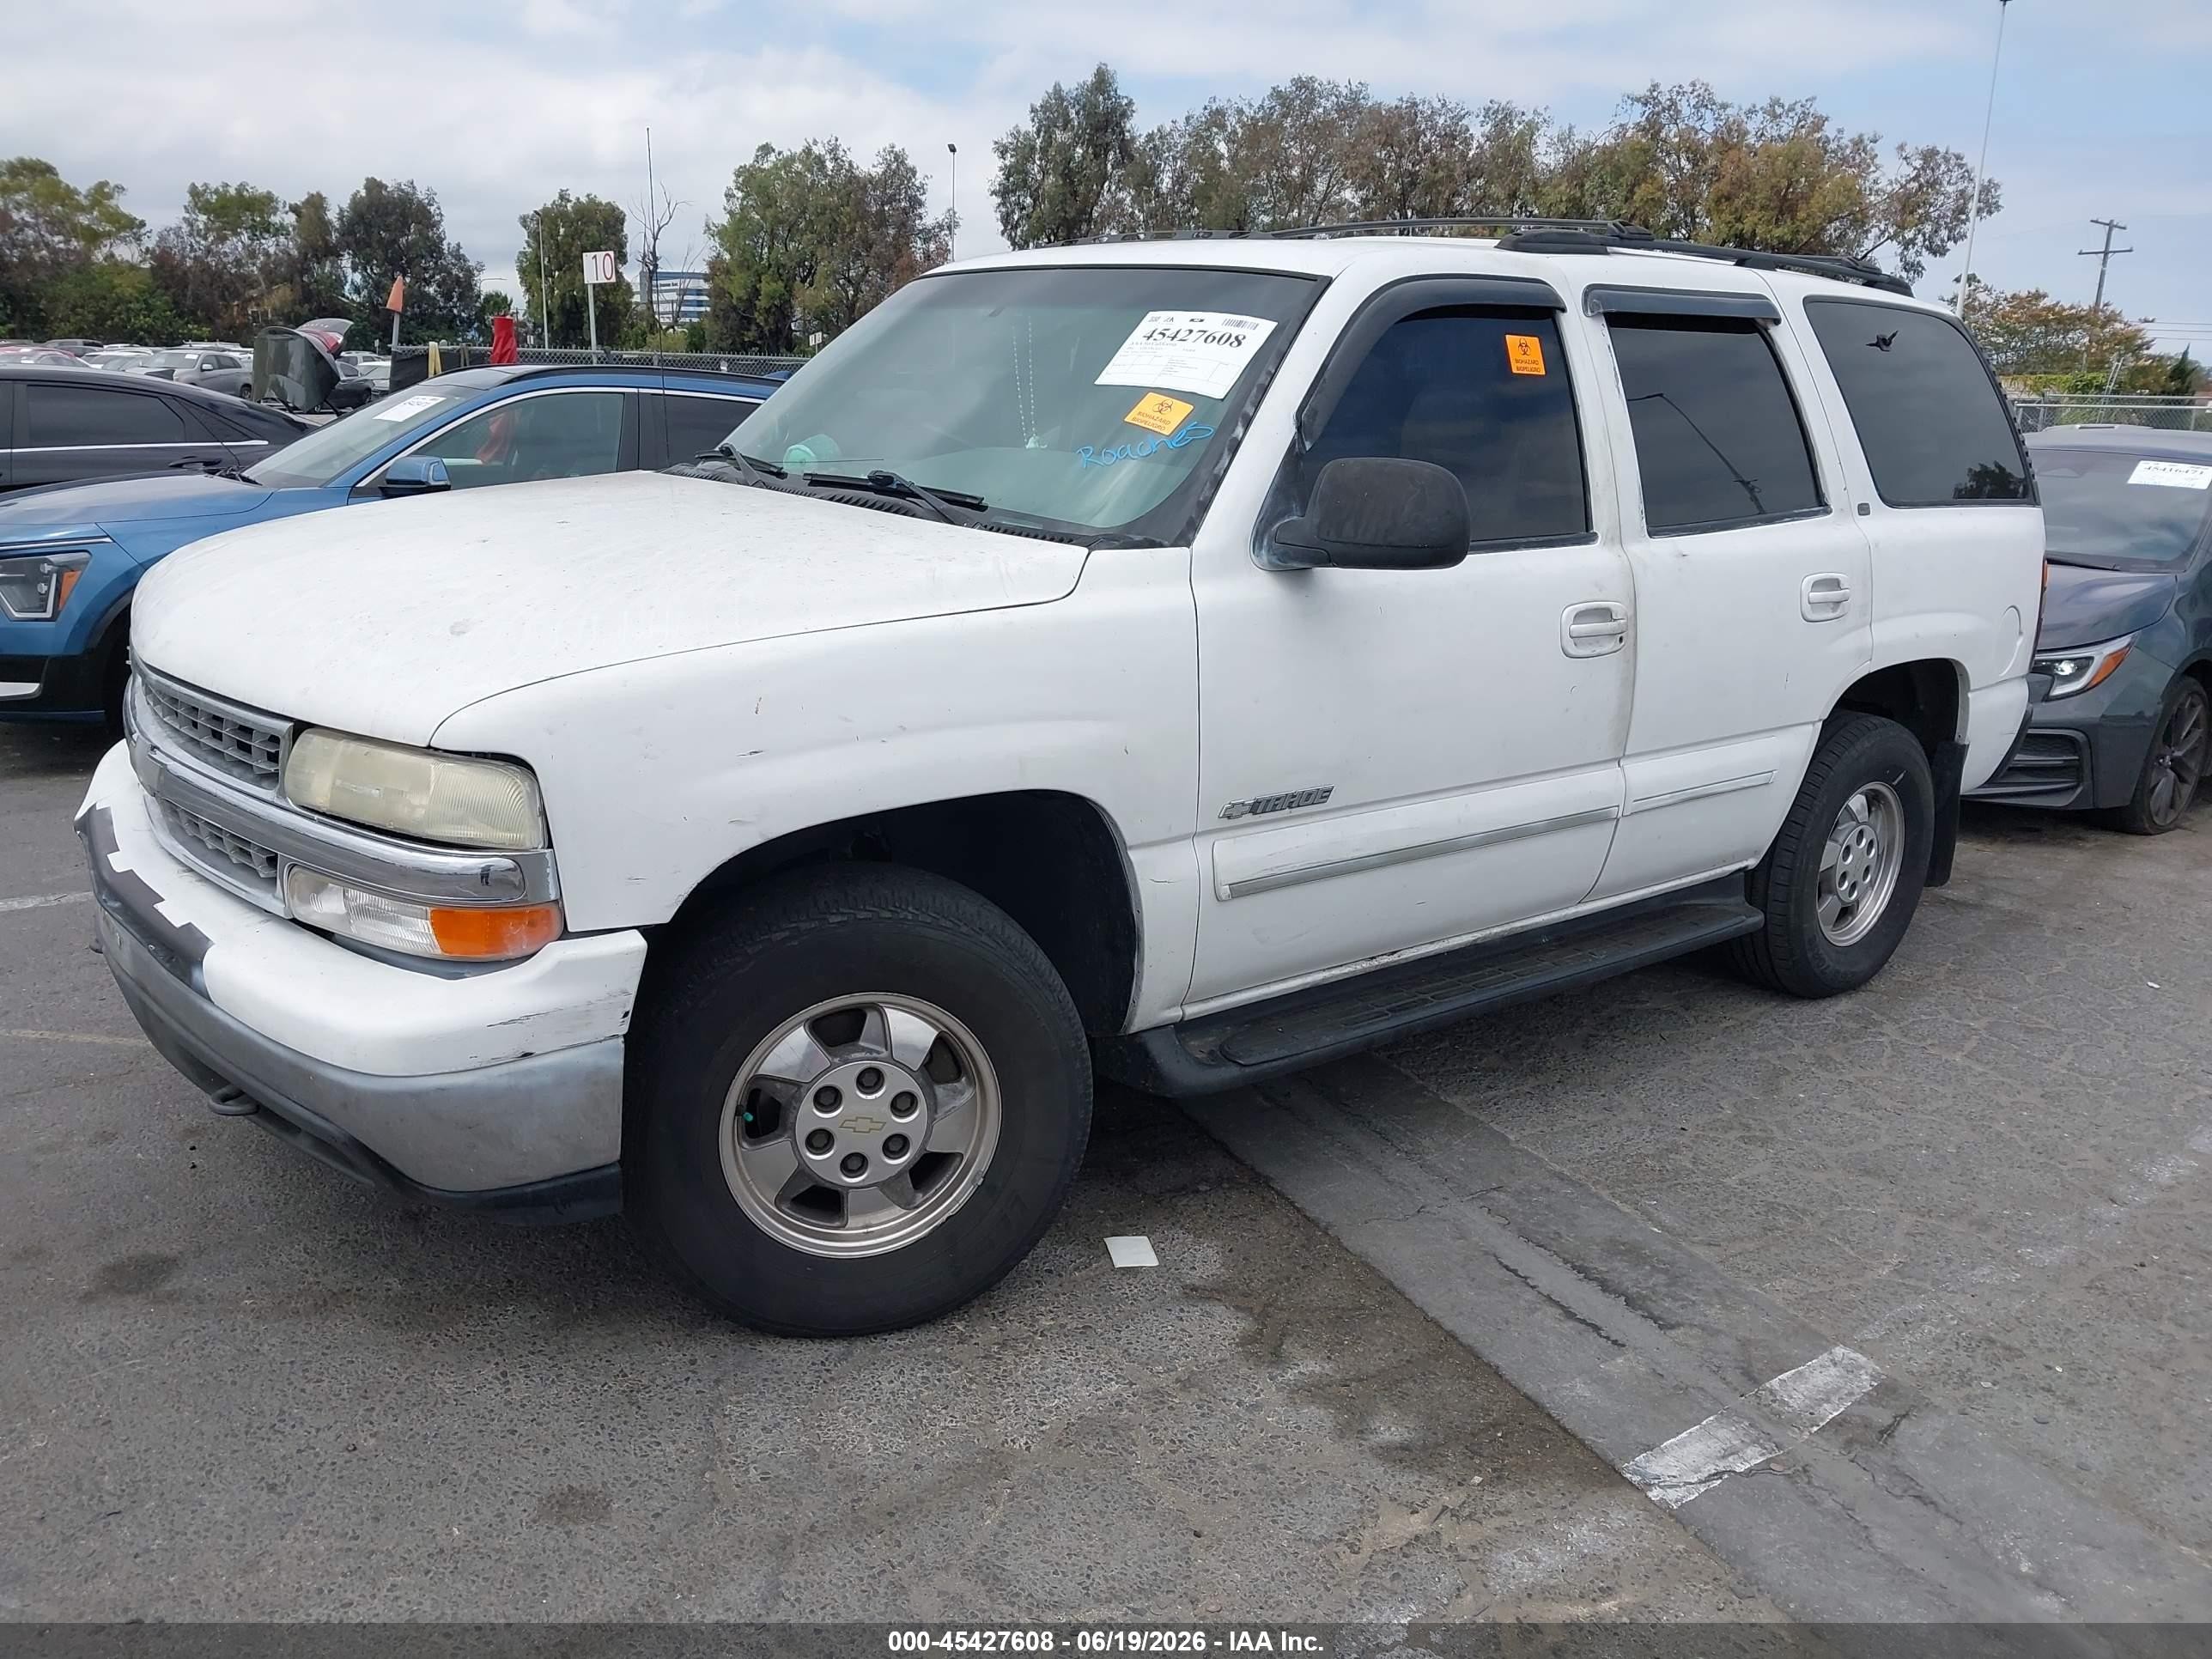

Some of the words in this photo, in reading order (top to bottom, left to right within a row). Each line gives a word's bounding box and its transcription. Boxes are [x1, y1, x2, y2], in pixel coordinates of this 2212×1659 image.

[592, 252, 614, 281] 10
[1142, 327, 1247, 349] 45427608
[1131, 416, 1166, 431] BIOPELIGRO
[1137, 410, 1171, 425] BIOHAZARD
[1255, 785, 1334, 814] TAHOE
